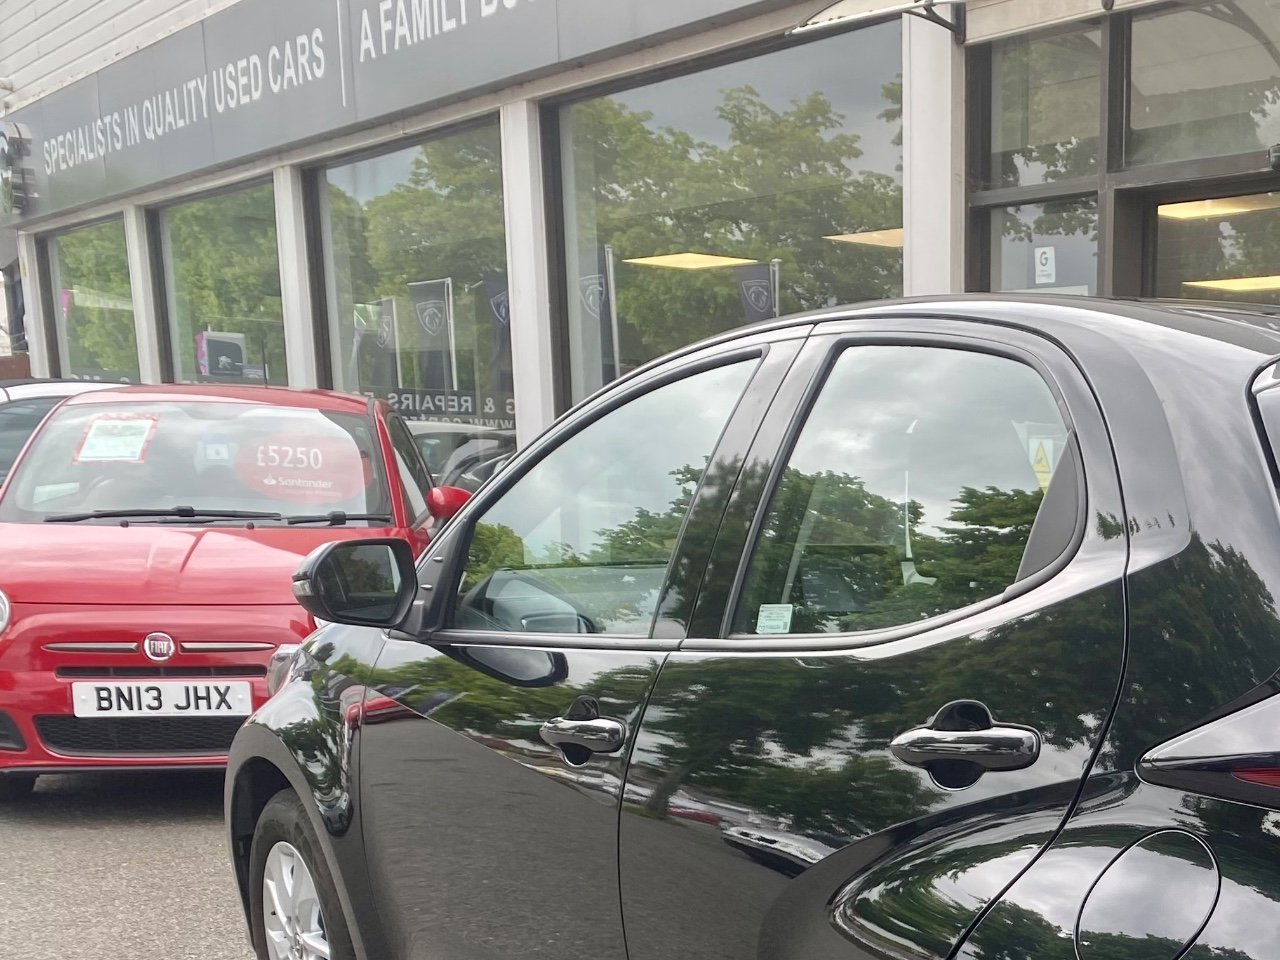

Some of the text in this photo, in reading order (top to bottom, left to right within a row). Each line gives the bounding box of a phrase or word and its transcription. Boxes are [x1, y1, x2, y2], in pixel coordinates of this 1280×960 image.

[360, 8, 376, 63] A
[43, 28, 325, 175] SPECIALISTS IN QUALITY USED CARS
[256, 445, 322, 470] £5250
[278, 476, 334, 489] Santander
[150, 640, 168, 654] FIAT
[94, 685, 233, 711] BN13 JHX
